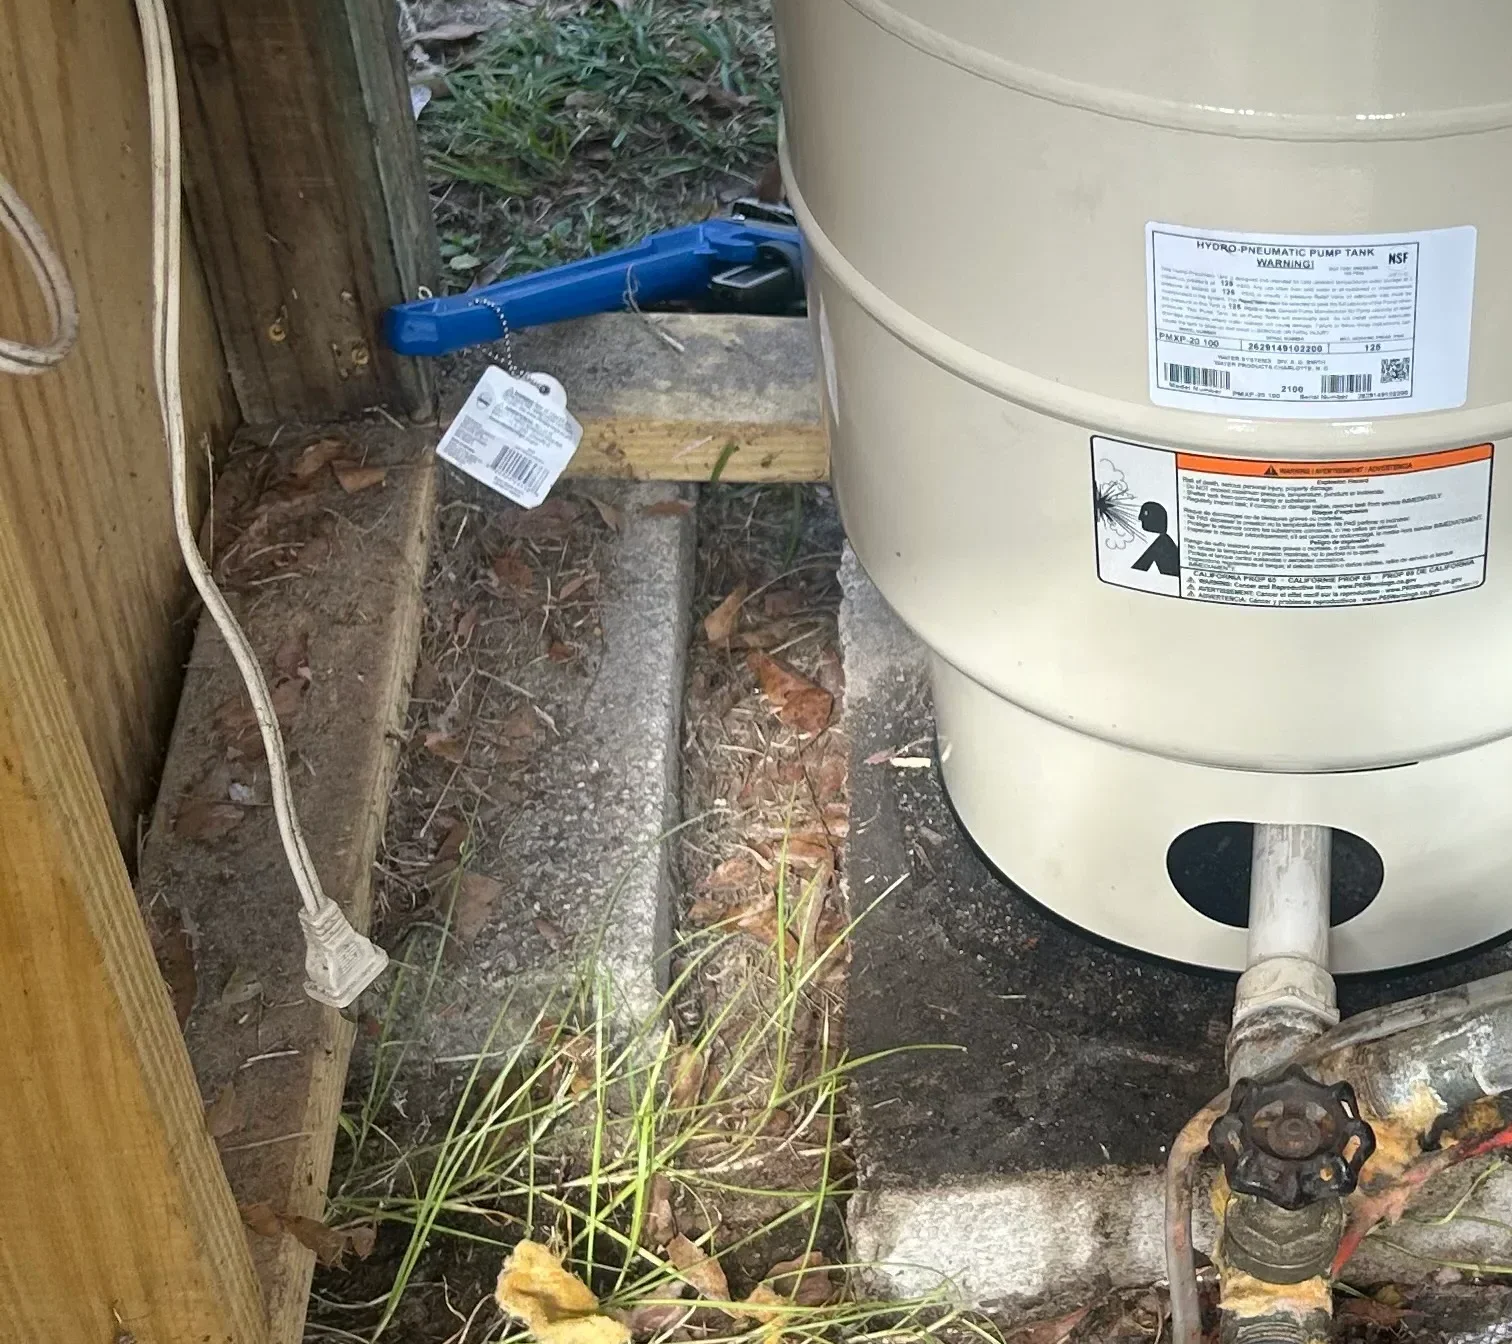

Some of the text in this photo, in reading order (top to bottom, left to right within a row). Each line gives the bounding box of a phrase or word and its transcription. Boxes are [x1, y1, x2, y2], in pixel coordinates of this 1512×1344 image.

[1310, 249, 1342, 257] PUMP
[1345, 248, 1375, 257] TANK
[1388, 252, 1409, 265] NSF
[1281, 385, 1304, 393] 2100
